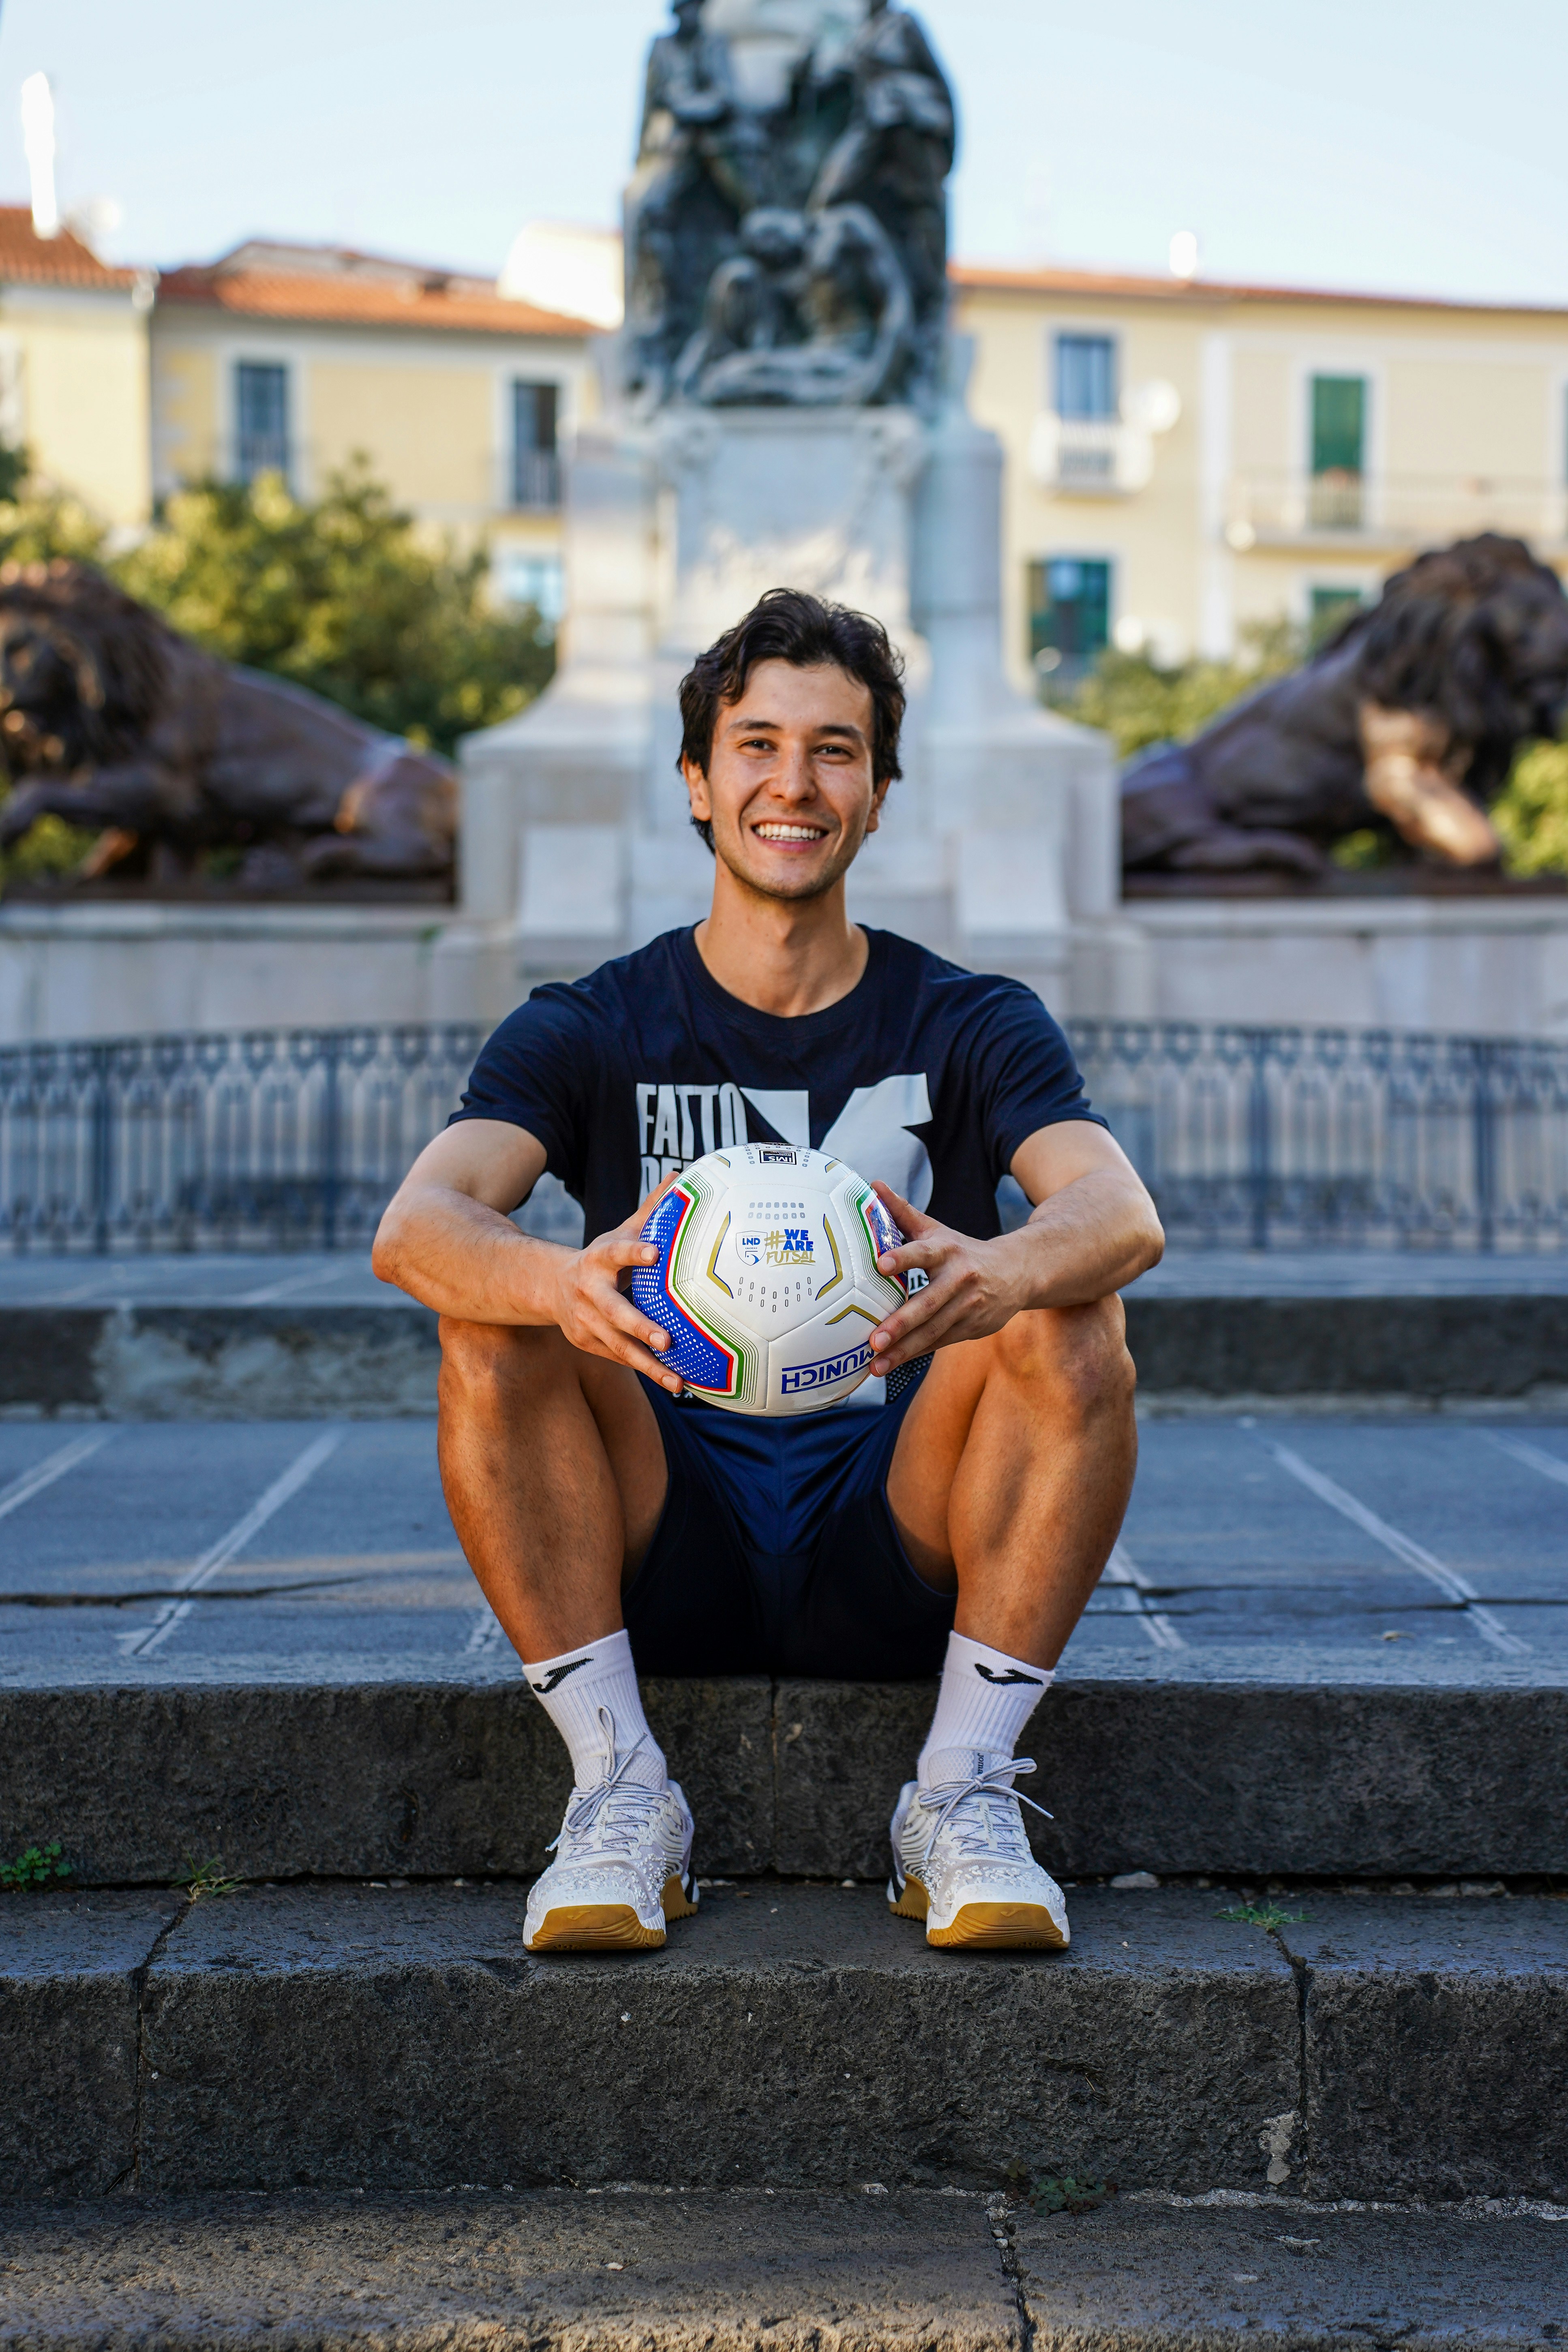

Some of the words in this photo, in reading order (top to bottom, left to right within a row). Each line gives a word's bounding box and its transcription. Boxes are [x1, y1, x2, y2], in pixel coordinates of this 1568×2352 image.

[636, 1082, 748, 1160] FATTO
[742, 1237, 760, 1246] LND
[783, 1240, 814, 1251] ARE
[766, 1251, 816, 1265] FUTSAL
[781, 1348, 874, 1394] MUNICH
